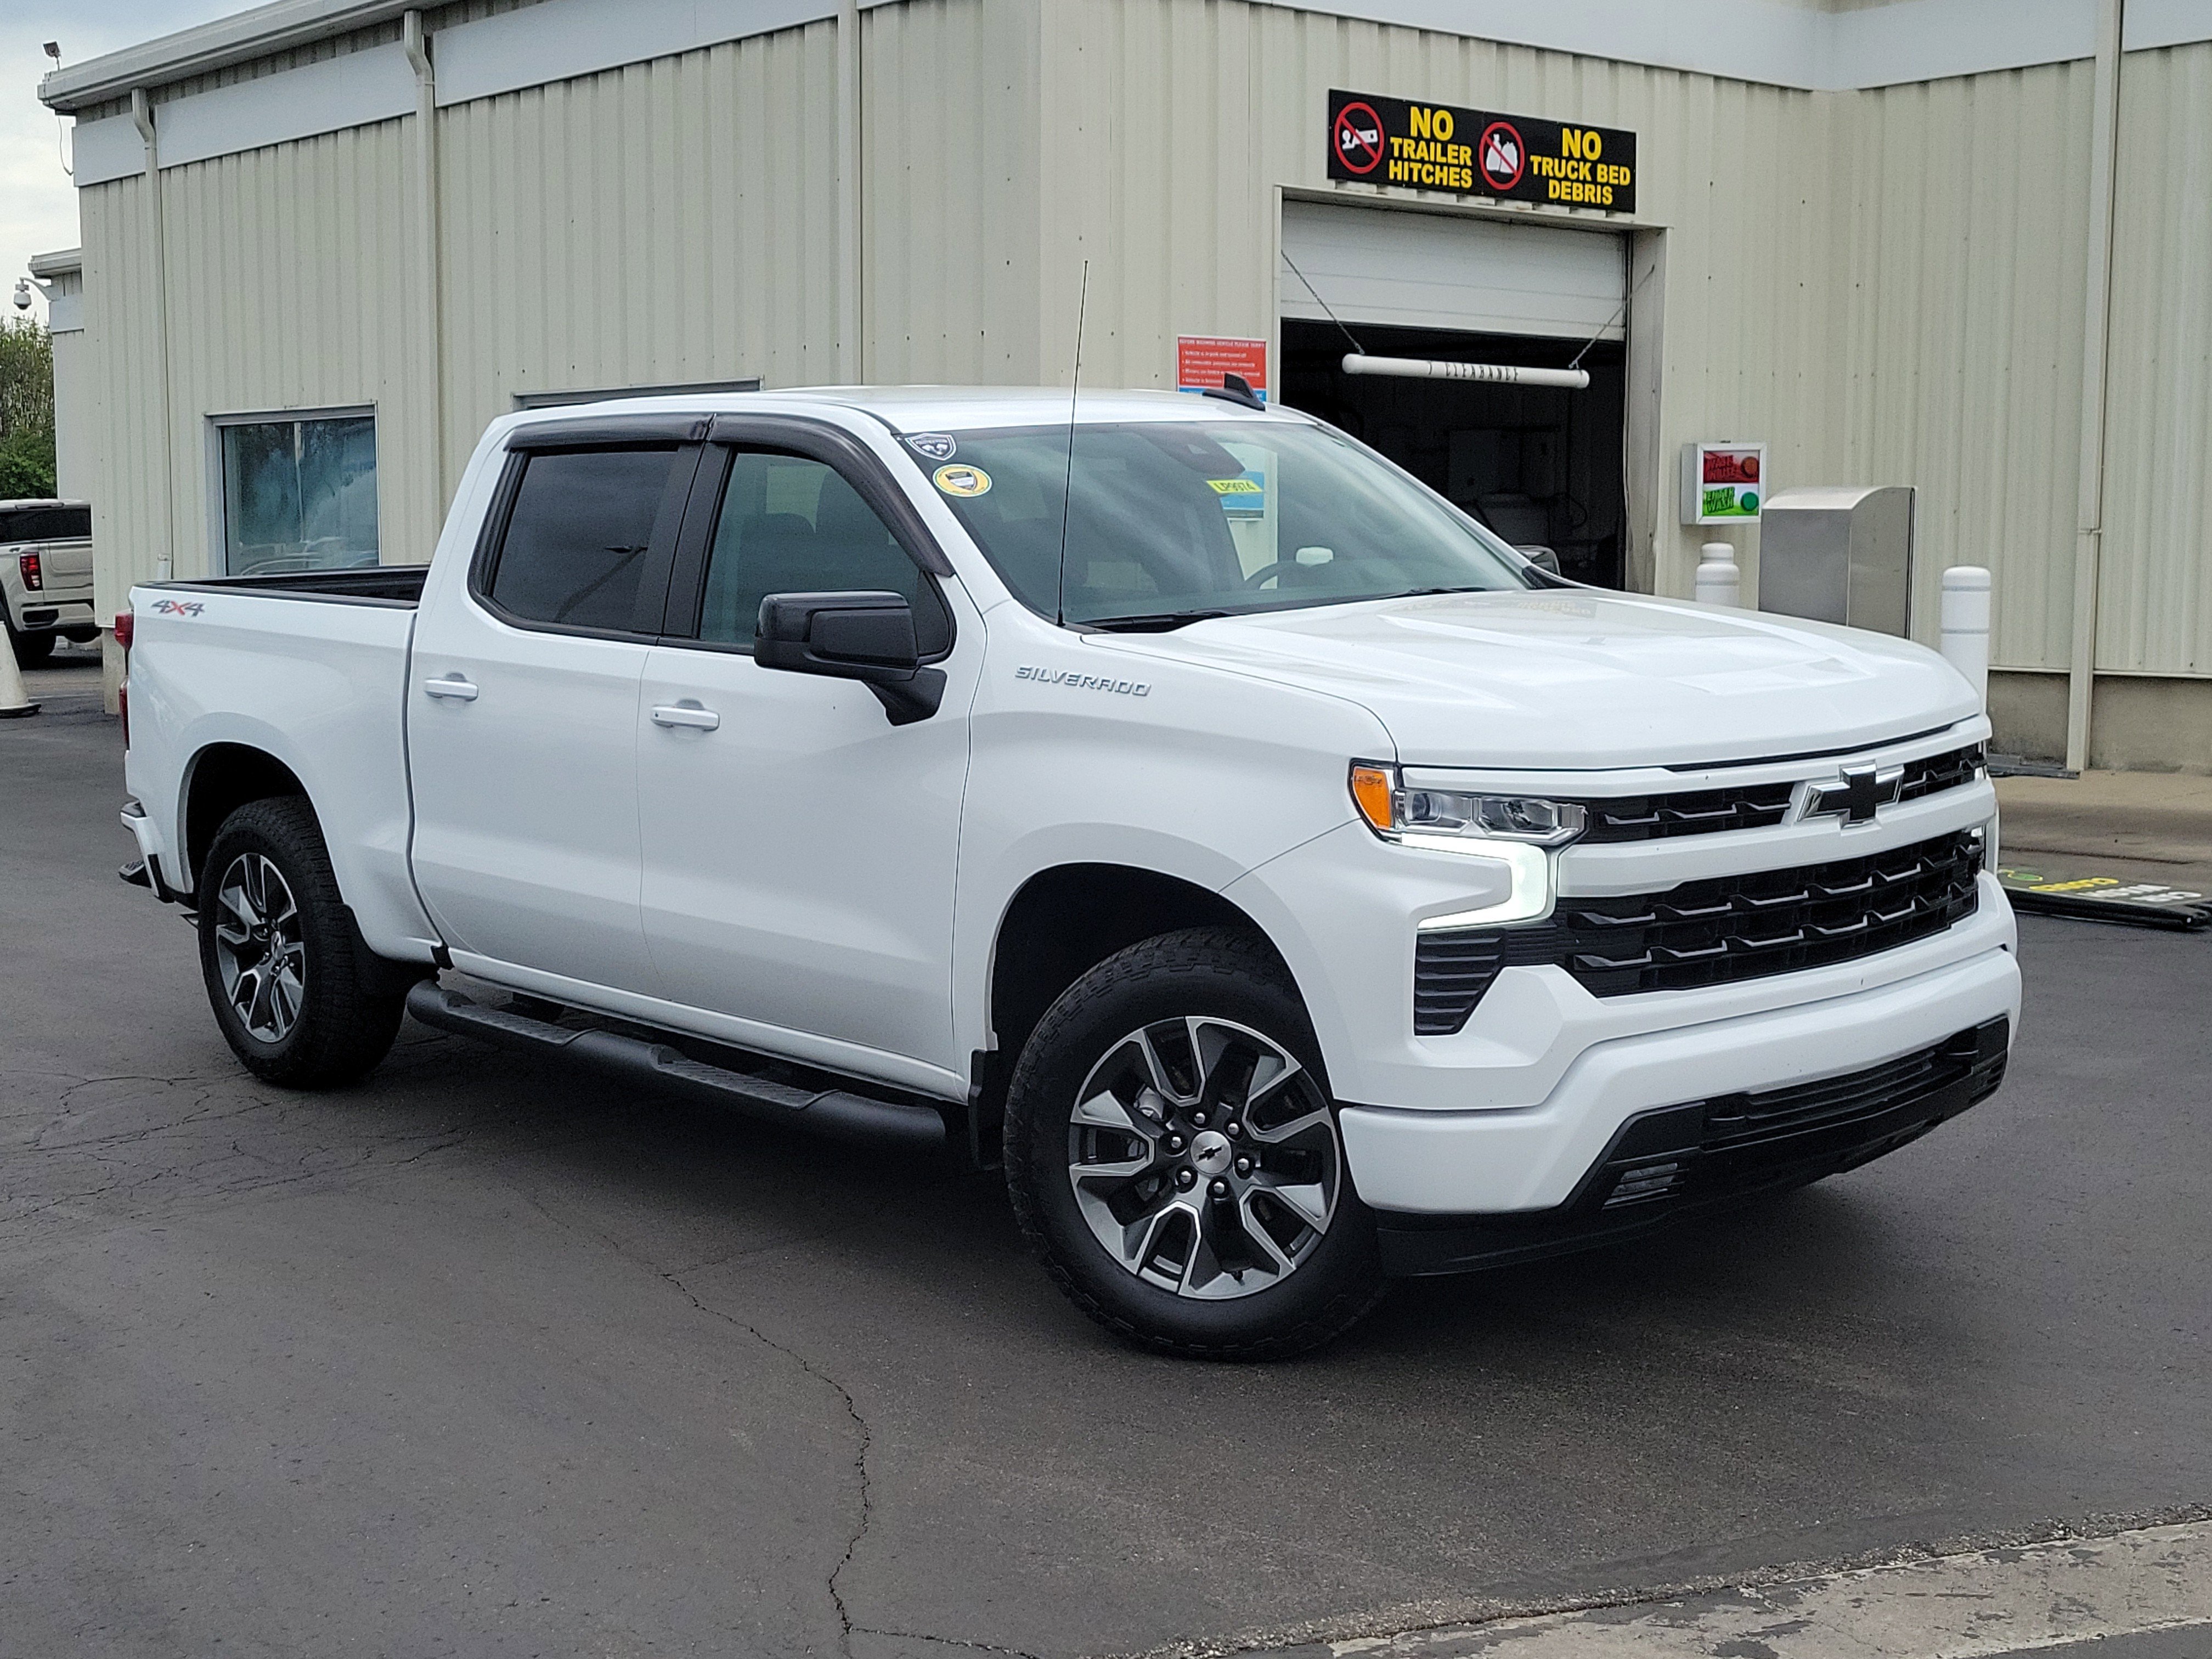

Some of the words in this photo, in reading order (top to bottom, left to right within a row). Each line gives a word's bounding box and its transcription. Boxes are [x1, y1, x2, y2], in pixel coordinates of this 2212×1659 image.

[1410, 106, 1454, 141] NO
[1390, 137, 1472, 166] TRAILER
[1562, 128, 1602, 161] NO
[1389, 159, 1473, 188] HITCHES
[1530, 155, 1592, 182] TRUCK
[1596, 163, 1631, 186] BED
[1548, 179, 1613, 205] DEBRIS
[1446, 363, 1519, 381] CLEARANCE
[1707, 494, 1734, 513] WASH
[1015, 665, 1151, 697] SILVERADO
